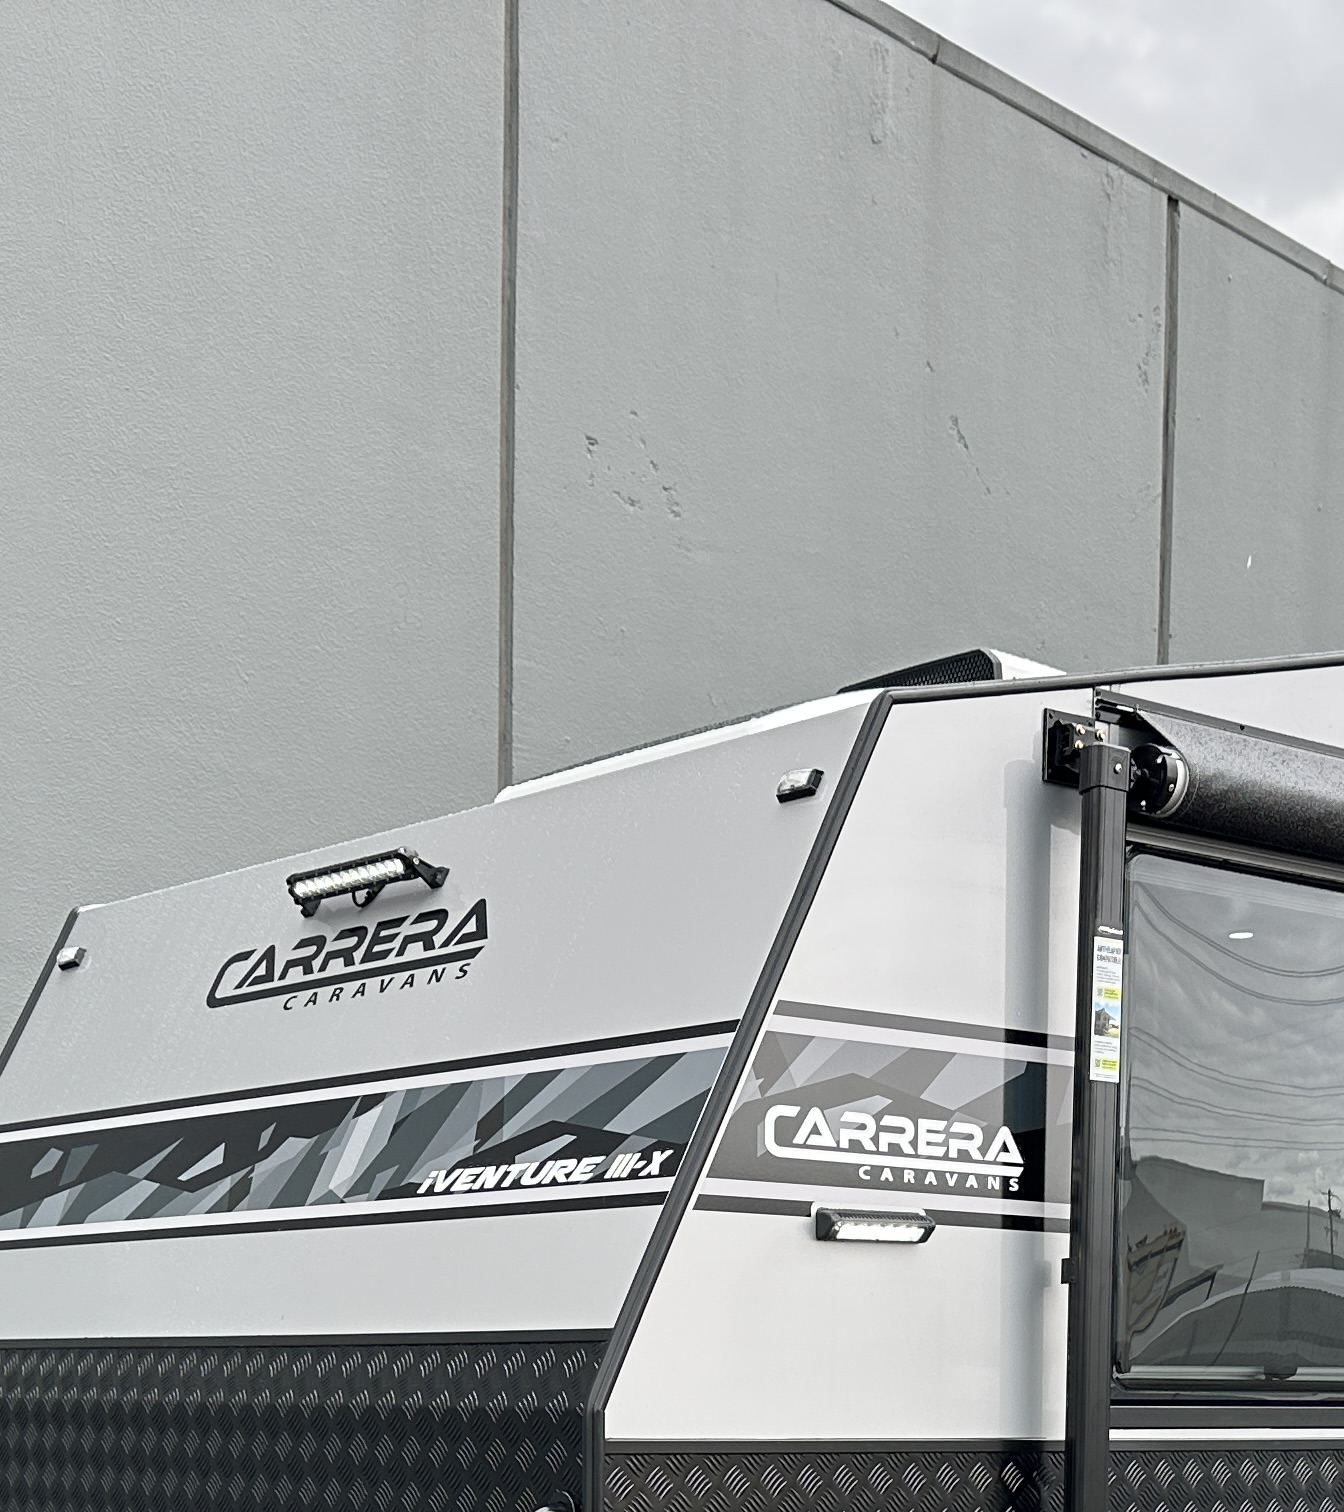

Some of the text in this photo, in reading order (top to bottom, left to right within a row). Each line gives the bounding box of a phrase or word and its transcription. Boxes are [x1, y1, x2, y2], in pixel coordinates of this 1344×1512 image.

[206, 898, 488, 1009] CARRERA
[283, 962, 472, 1011] CARAVANS
[764, 1104, 1025, 1177] CARRERA
[416, 1155, 607, 1195] iVENTURE
[858, 1164, 1020, 1192] CARAVANS
